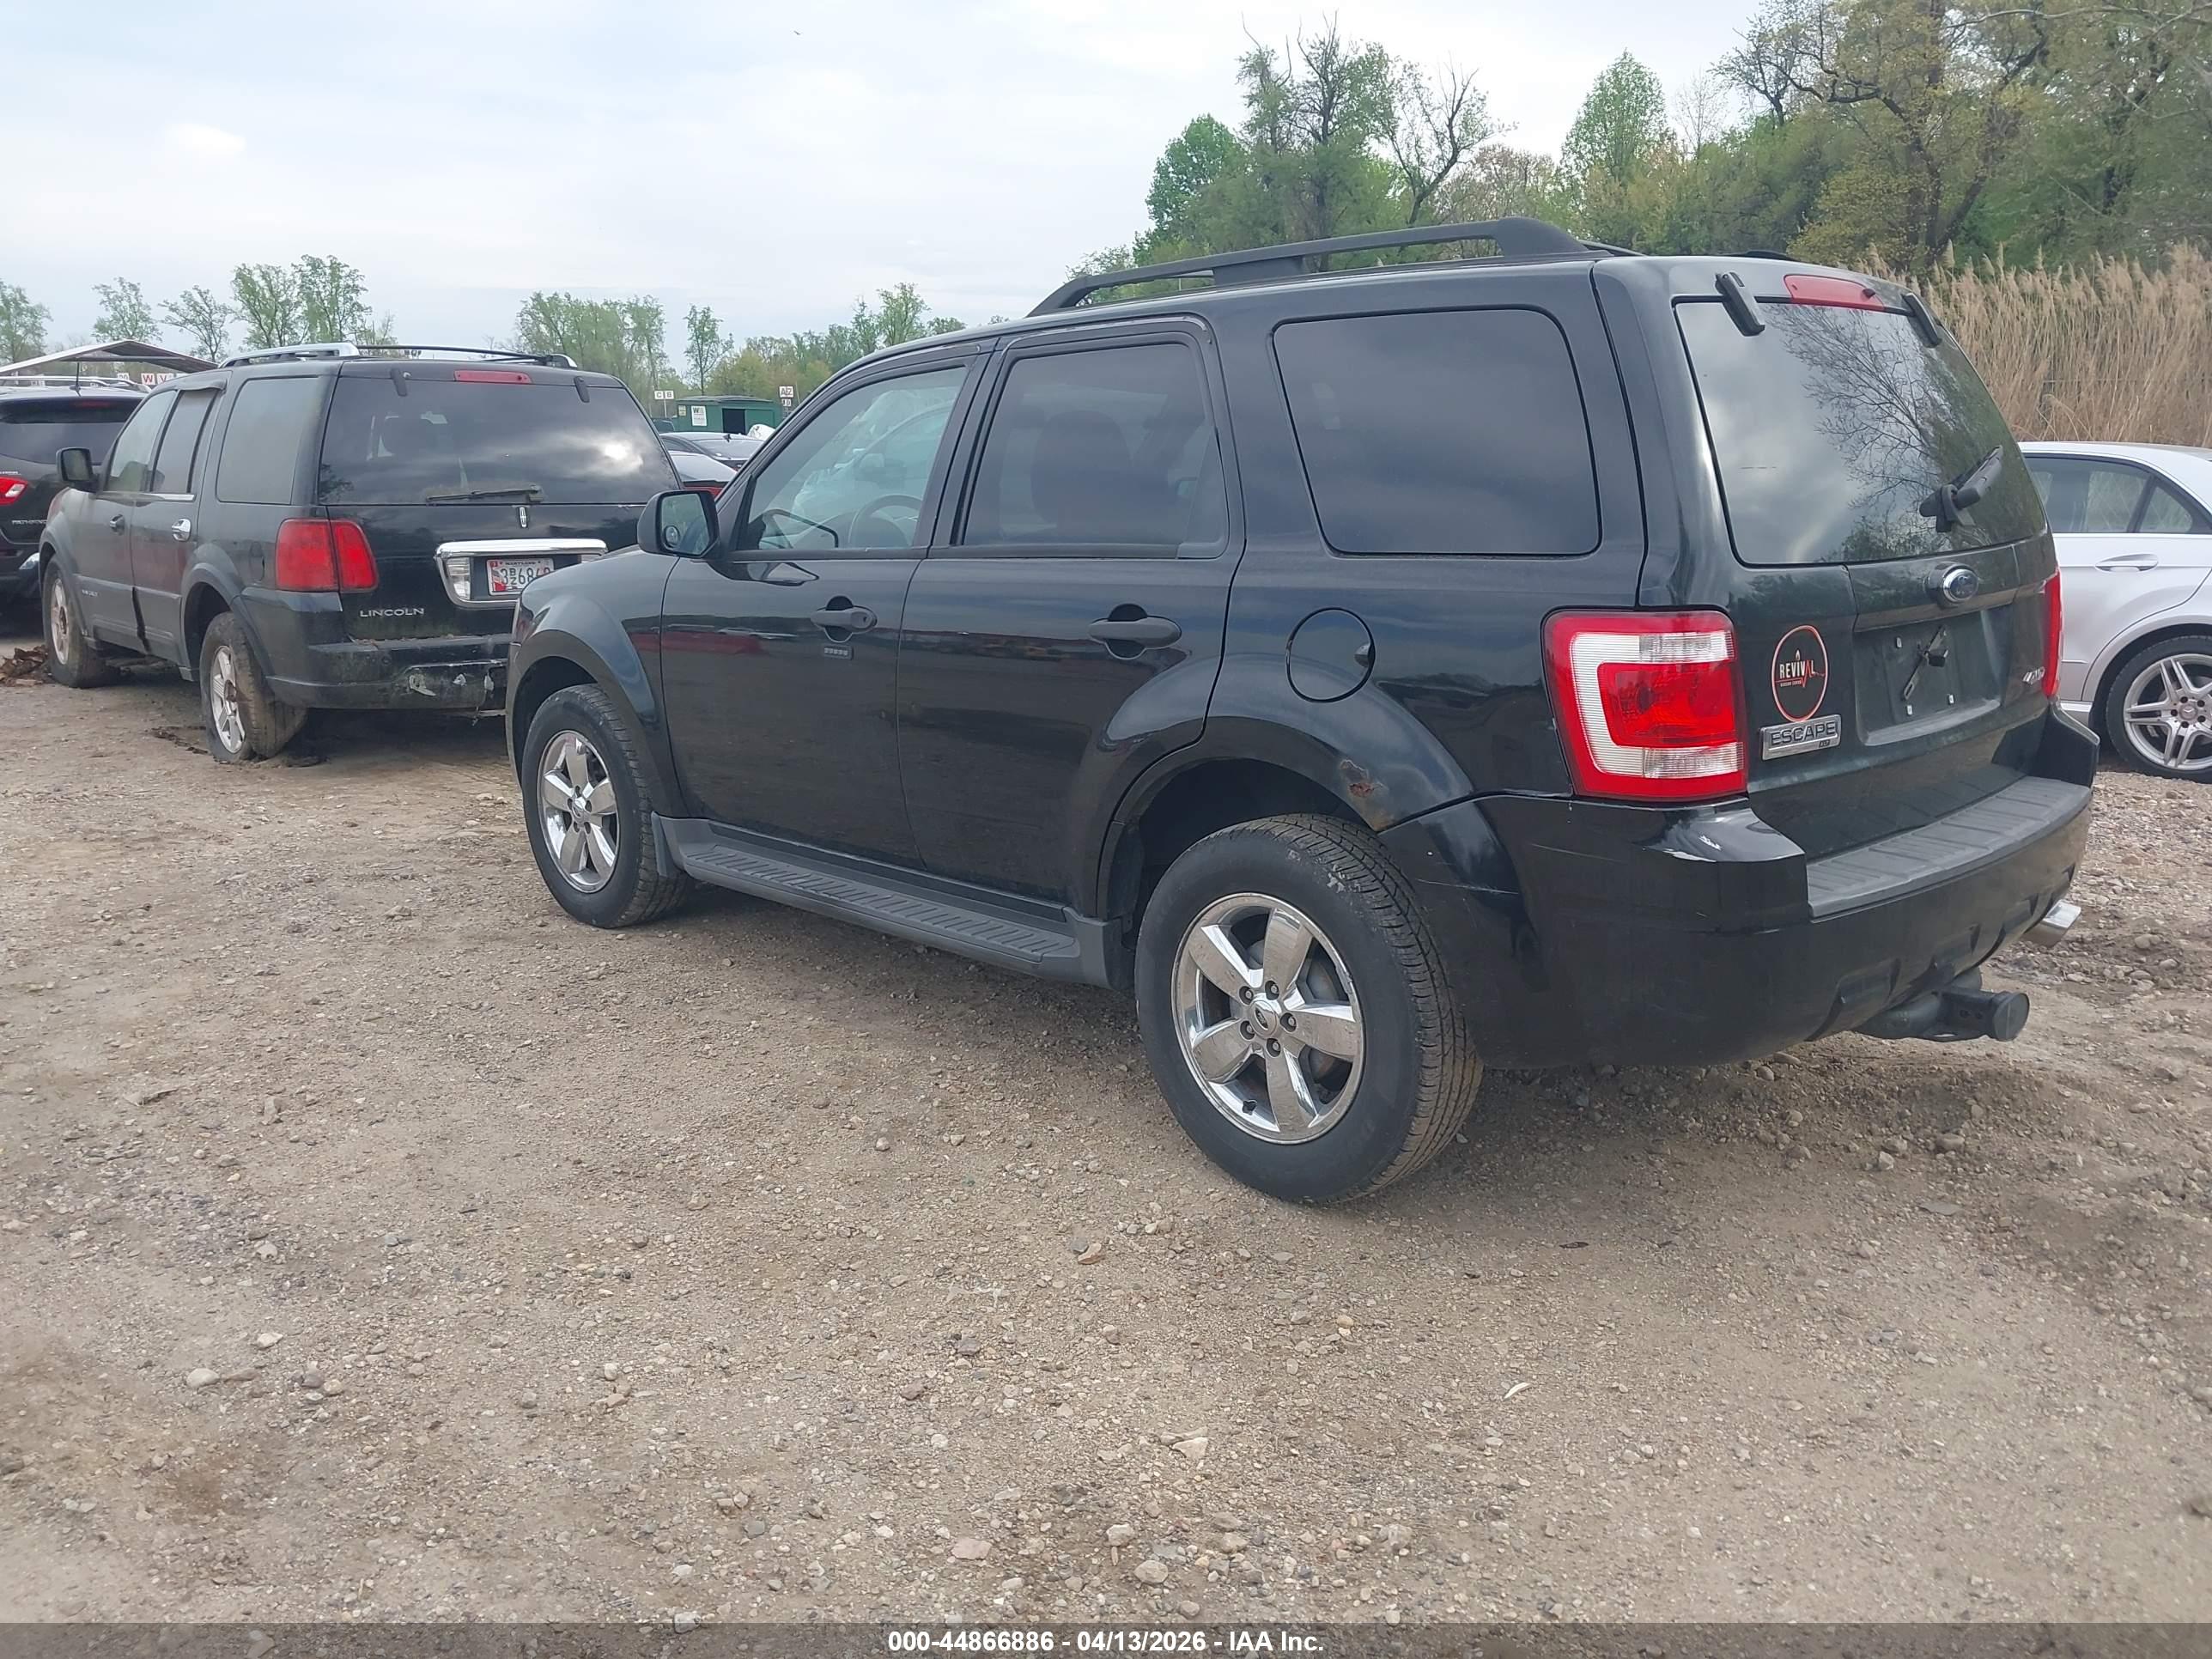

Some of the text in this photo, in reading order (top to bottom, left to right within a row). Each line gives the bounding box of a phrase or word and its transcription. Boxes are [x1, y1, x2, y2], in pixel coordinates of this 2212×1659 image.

[143, 374, 153, 383] W
[359, 606, 425, 617] LINCOLN
[1779, 659, 1816, 679] REVIVAL
[1771, 720, 1837, 745] ESCAPE
